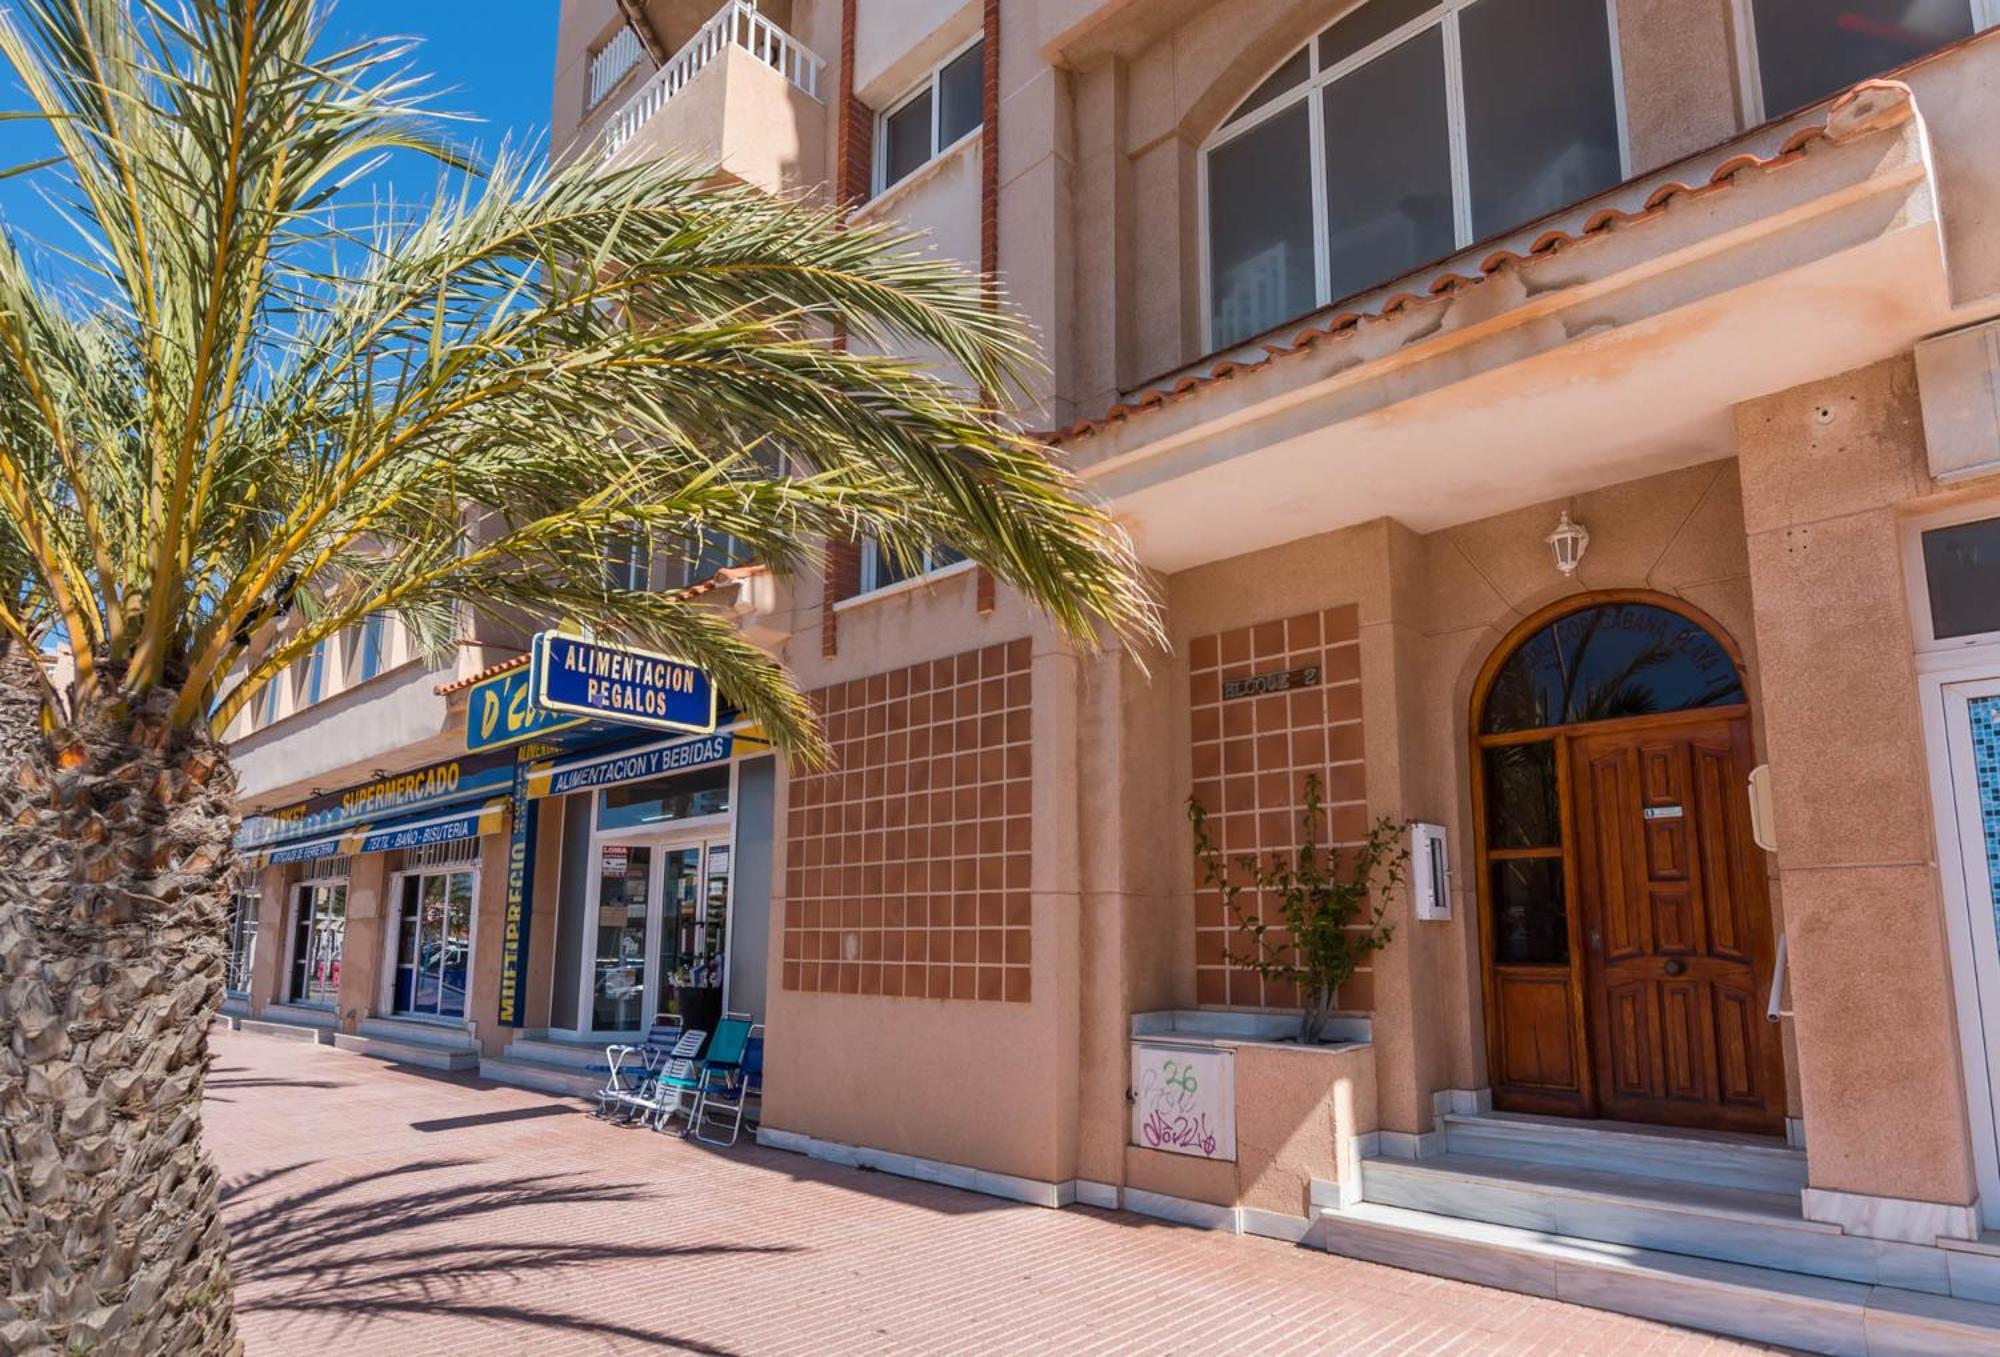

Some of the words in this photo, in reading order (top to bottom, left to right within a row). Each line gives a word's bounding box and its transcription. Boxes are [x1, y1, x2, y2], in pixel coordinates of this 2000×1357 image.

[564, 644, 694, 694] ALIMENTACION
[1224, 672, 1290, 699] BLOQUE
[1303, 668, 1317, 686] 2
[555, 753, 647, 793] ALIMENTACION
[650, 752, 660, 772] Y
[662, 737, 724, 770] BEBIDAS
[342, 762, 460, 817] SUPERMERCADO
[394, 828, 418, 847] BAÑO
[422, 820, 469, 843] BISUTERIA
[1163, 1060, 1198, 1094] 26
